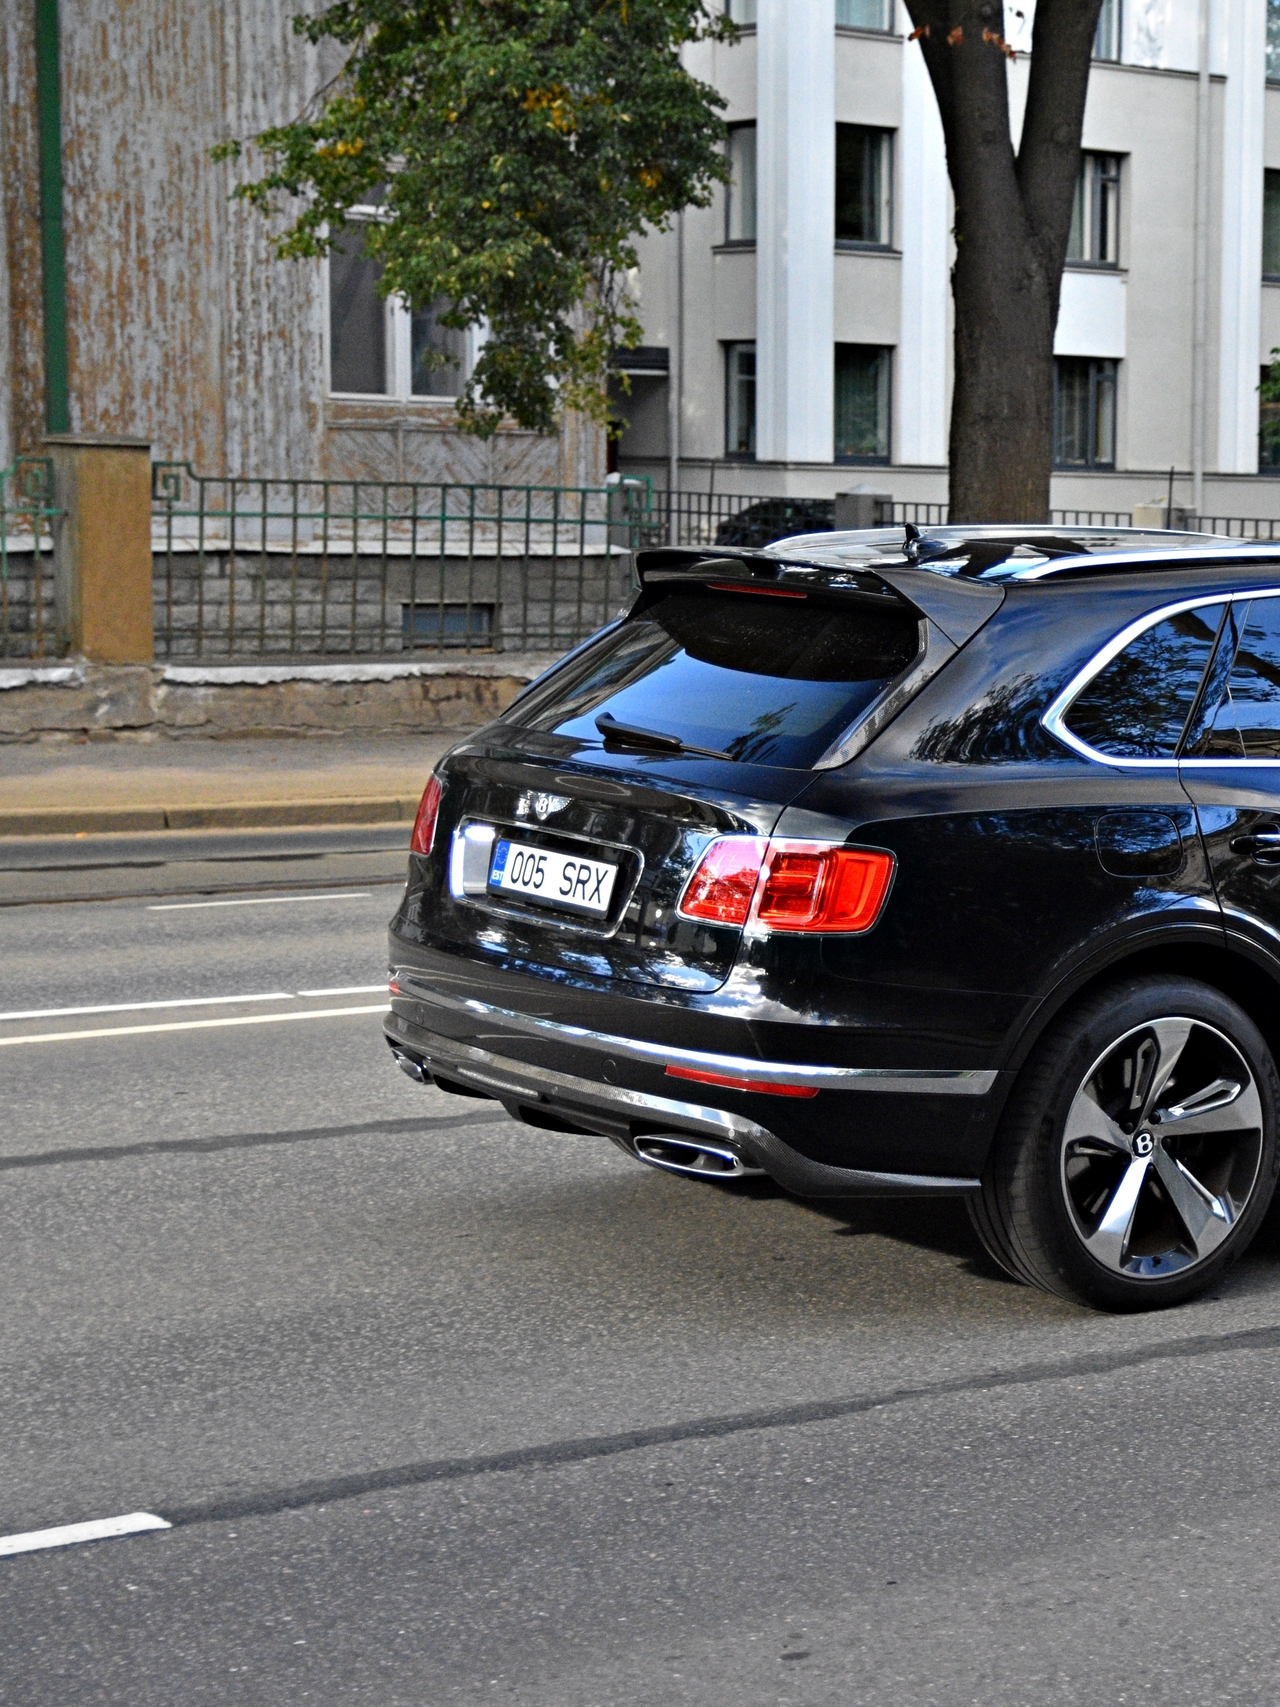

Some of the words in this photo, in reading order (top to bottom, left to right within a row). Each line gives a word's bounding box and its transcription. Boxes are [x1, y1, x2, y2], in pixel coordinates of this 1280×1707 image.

[491, 869, 504, 881] EST
[510, 851, 548, 889] 005
[559, 861, 609, 904] SRX
[1136, 1133, 1154, 1154] B
